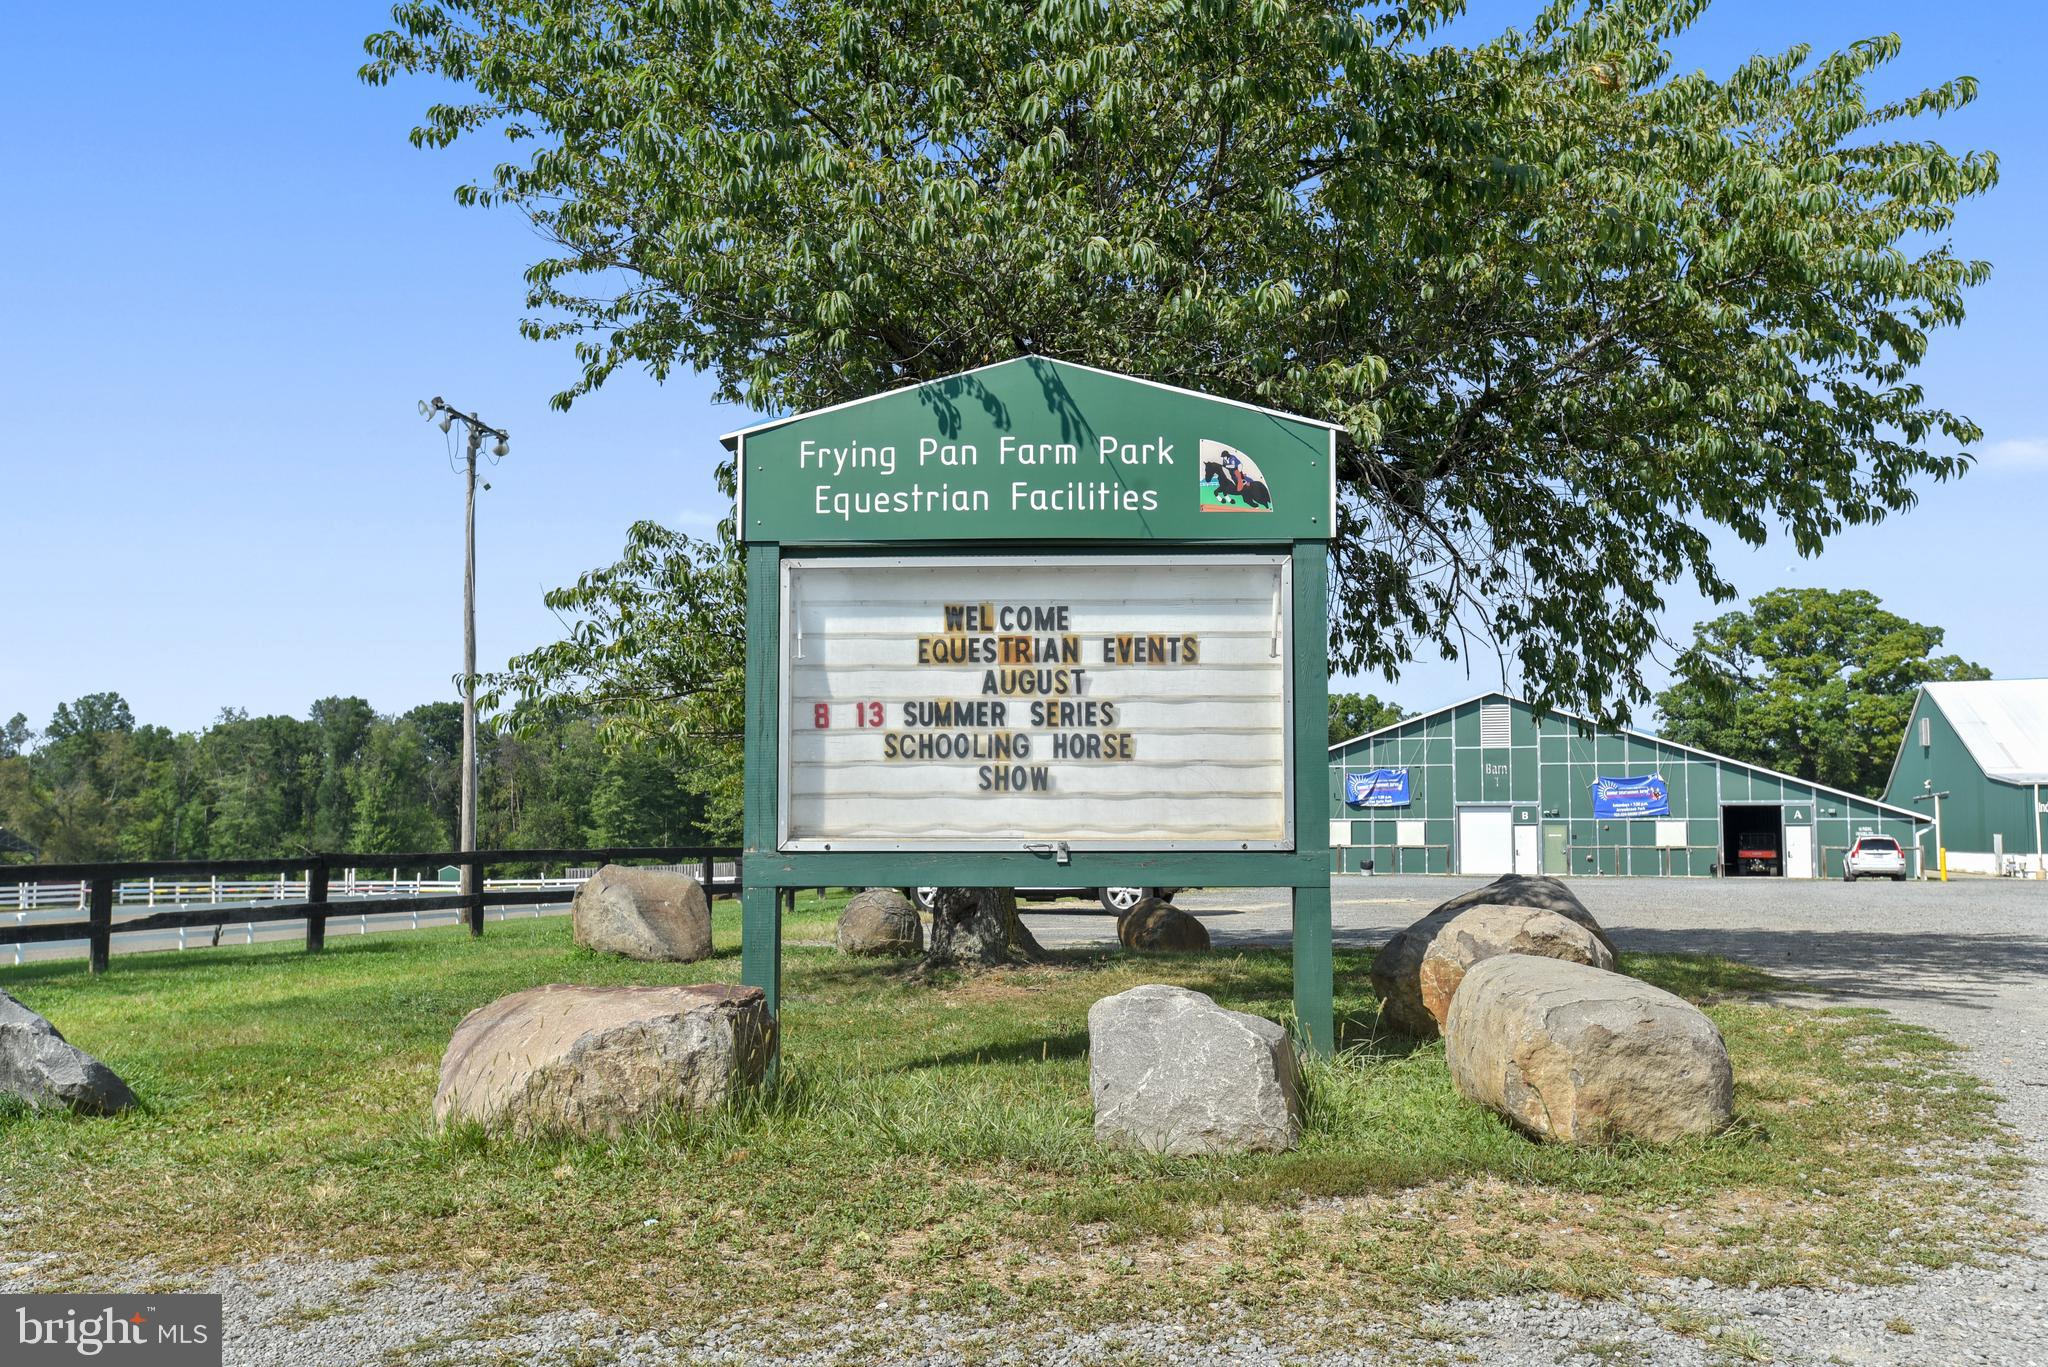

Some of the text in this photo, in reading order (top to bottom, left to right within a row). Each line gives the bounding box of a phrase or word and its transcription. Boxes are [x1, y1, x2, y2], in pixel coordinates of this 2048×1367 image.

[800, 436, 1174, 476] Frying Pan Farm Park
[815, 481, 1158, 521] Equestrian Facilities
[944, 605, 1069, 632] WELCOME
[918, 636, 1197, 664] EQUESTRIAN EVENTS
[981, 669, 1086, 695] AUGUST
[814, 701, 1114, 729] 8 13 SUMMER SERIES
[884, 733, 1132, 759] SCHOOLING HORSE
[979, 765, 1049, 792] SHOW
[1485, 763, 1508, 775] Barn
[1521, 811, 1529, 820] B
[1793, 809, 1803, 820] A
